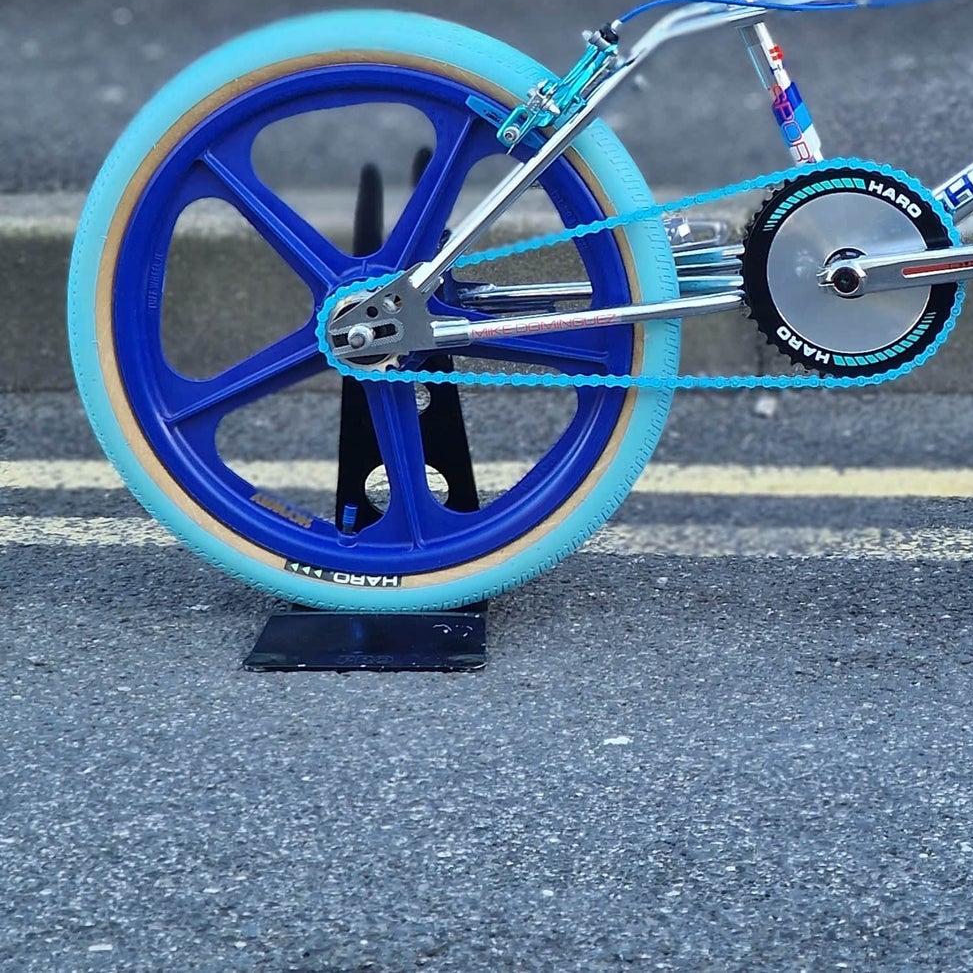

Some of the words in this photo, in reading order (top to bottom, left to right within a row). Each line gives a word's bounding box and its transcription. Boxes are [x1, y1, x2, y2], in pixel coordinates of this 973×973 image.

[767, 85, 817, 164] SPOR
[868, 180, 921, 218] HARO
[471, 326, 513, 339] MIKE
[515, 313, 617, 334] DOMINGUEZ
[777, 326, 829, 364] HARO
[333, 572, 398, 587] HARO
